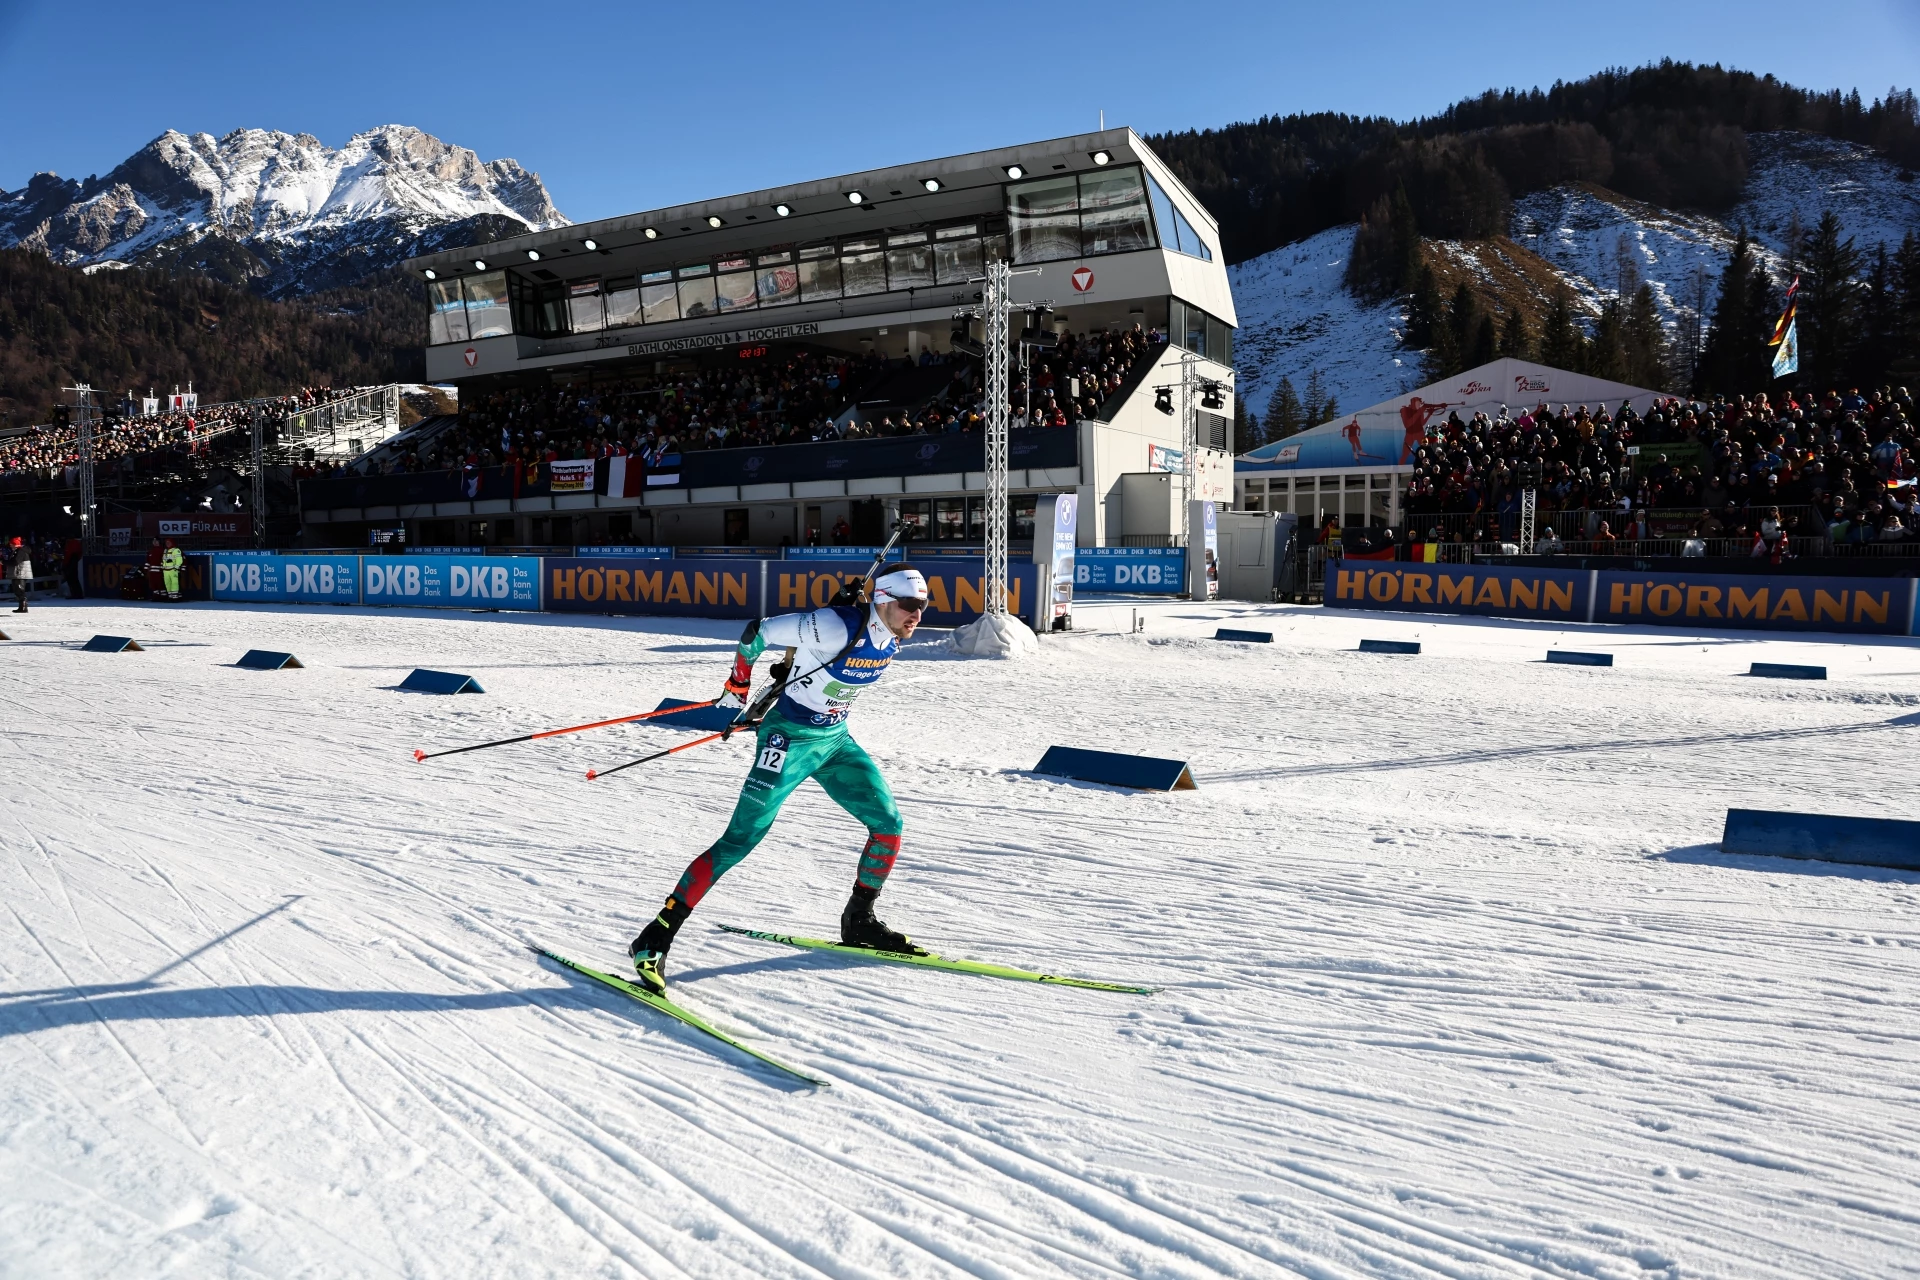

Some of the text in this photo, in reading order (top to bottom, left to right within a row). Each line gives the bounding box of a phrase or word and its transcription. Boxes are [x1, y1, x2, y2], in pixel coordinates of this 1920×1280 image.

[628, 322, 819, 356] BIATHLONSTADION HOCHFILZEN
[162, 523, 189, 532] ORF
[212, 523, 237, 532] ALLE
[111, 530, 130, 542] ORF
[264, 564, 274, 573] Das
[337, 565, 350, 574] Das
[424, 566, 437, 575] Das
[513, 567, 528, 577] Das
[216, 564, 261, 592] DKB
[264, 574, 278, 582] kann
[286, 564, 335, 594] DKB
[1115, 565, 1161, 584] DKB
[338, 576, 352, 584] kann
[367, 565, 420, 596] DKB
[424, 577, 440, 586] kann
[450, 566, 510, 598] DKB
[513, 579, 531, 589] kann
[264, 583, 279, 592] Bank
[338, 586, 353, 595] Bank
[553, 566, 747, 606] HÖRMANN
[1336, 568, 1573, 611] HÖRMANN
[424, 587, 441, 597] Bank
[513, 590, 532, 600] Bank
[1610, 581, 1889, 624] HÖRMANN
[842, 669, 872, 679] Garage
[764, 750, 781, 768] 12
[876, 951, 913, 960] FISCHER
[627, 985, 653, 998] FISCHER
